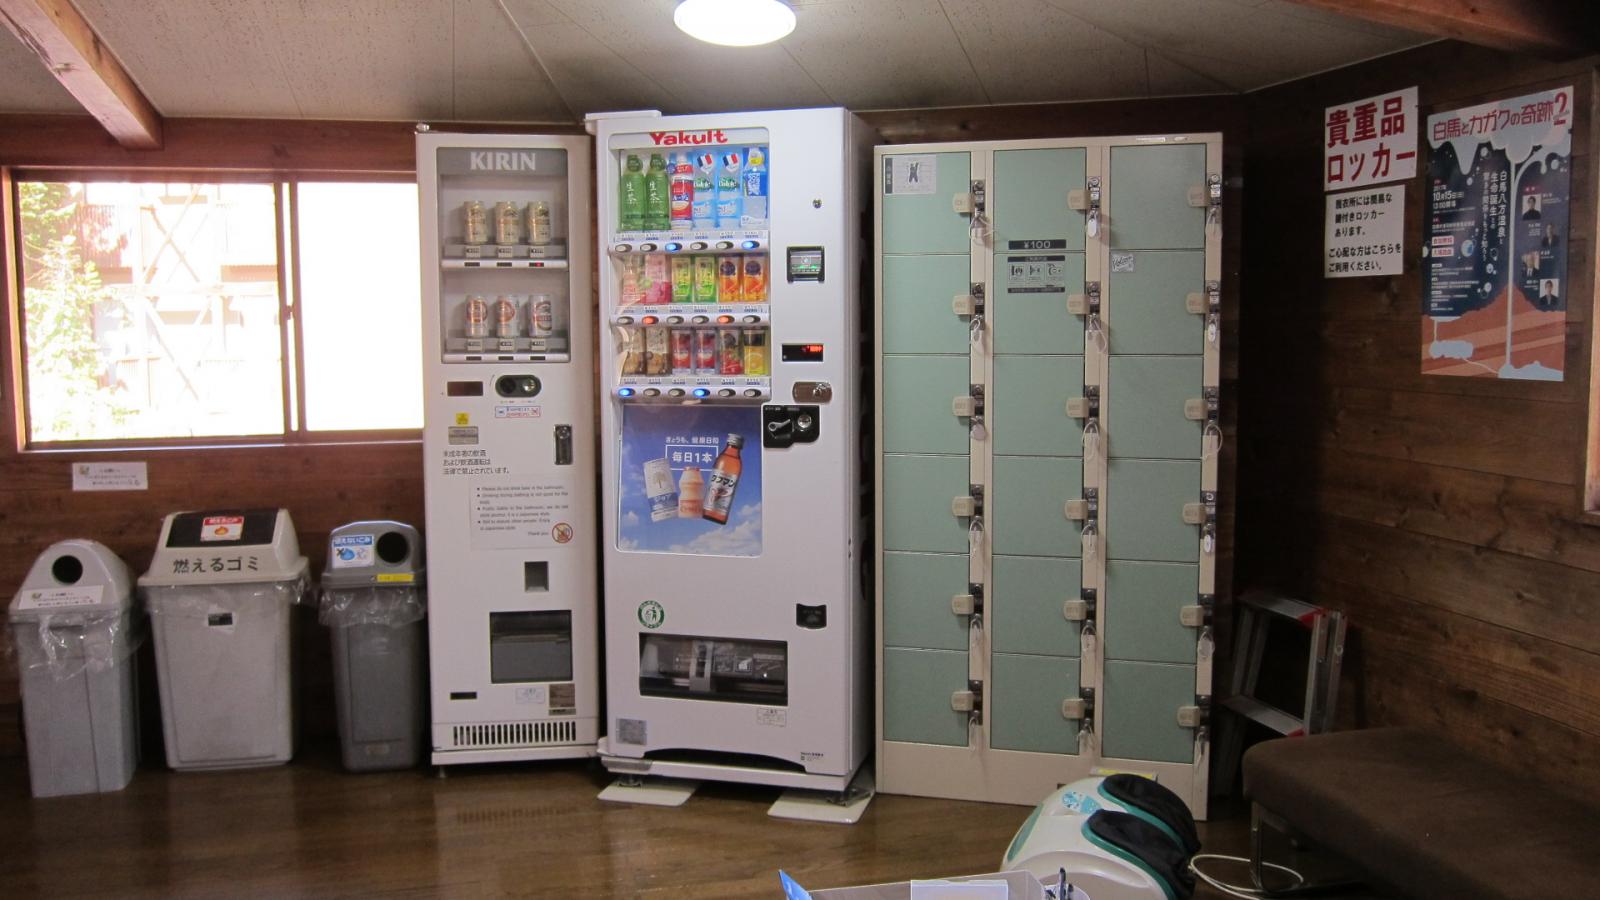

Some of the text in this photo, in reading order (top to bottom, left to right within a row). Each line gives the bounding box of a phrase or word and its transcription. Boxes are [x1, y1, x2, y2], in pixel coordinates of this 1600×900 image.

[1326, 96, 1405, 149] 貴重品
[649, 128, 728, 146] Yakult
[470, 151, 536, 171] KIRIN
[1327, 142, 1416, 183] ロッカー
[1335, 226, 1366, 238] あります。
[1328, 243, 1402, 258] ご心配な方はこちらを
[1328, 261, 1382, 273] ご利用ください。
[671, 451, 713, 464] 毎日1本
[173, 556, 258, 574] 燃えるゴミ
